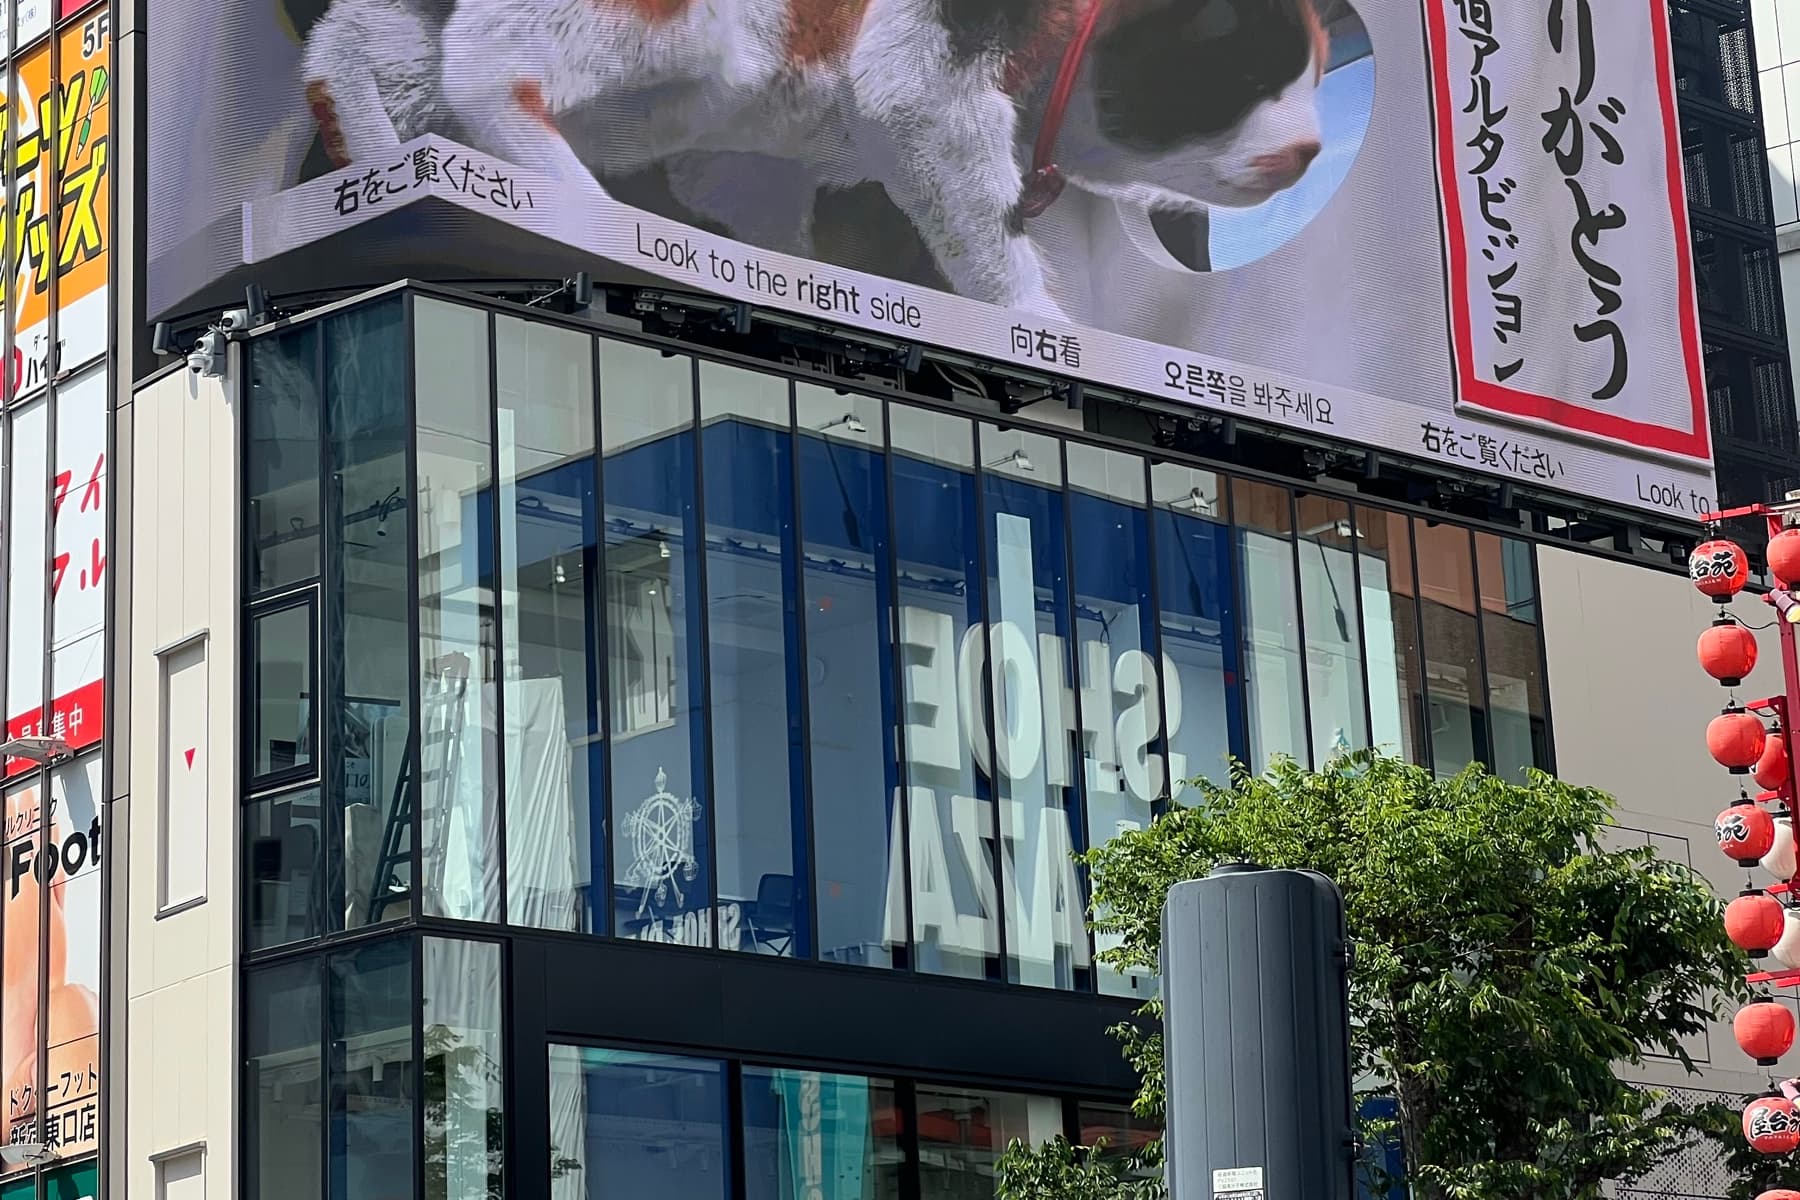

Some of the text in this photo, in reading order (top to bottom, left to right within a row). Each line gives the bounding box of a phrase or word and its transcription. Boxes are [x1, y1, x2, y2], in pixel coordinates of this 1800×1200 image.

[334, 145, 534, 215] 右をご覧ください
[636, 222, 922, 328] Look to the right side
[1010, 323, 1082, 369] 向右看
[1164, 360, 1335, 425] 오른쪽을 봐주세요
[1420, 420, 1565, 480] 右をご覧ください
[1635, 473, 1711, 515] Look to
[11, 814, 101, 901] Foot
